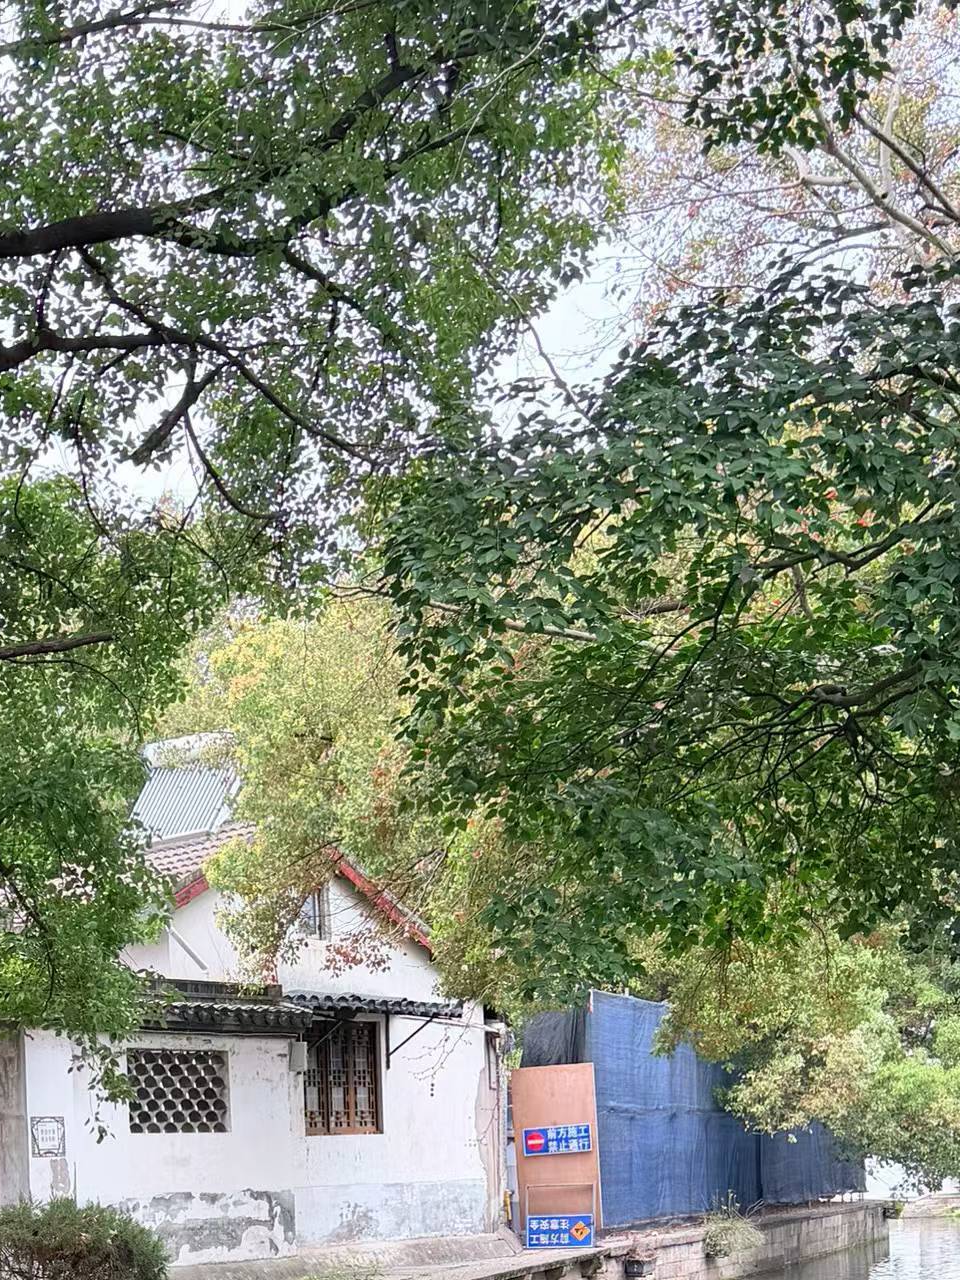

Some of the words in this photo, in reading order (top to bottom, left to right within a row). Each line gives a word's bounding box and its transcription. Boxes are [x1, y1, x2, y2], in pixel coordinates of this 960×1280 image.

[547, 1126, 589, 1140] 前方施工
[548, 1139, 589, 1153] 禁止通行
[530, 1219, 570, 1231] 注意安全
[530, 1233, 569, 1244] 前方施工
